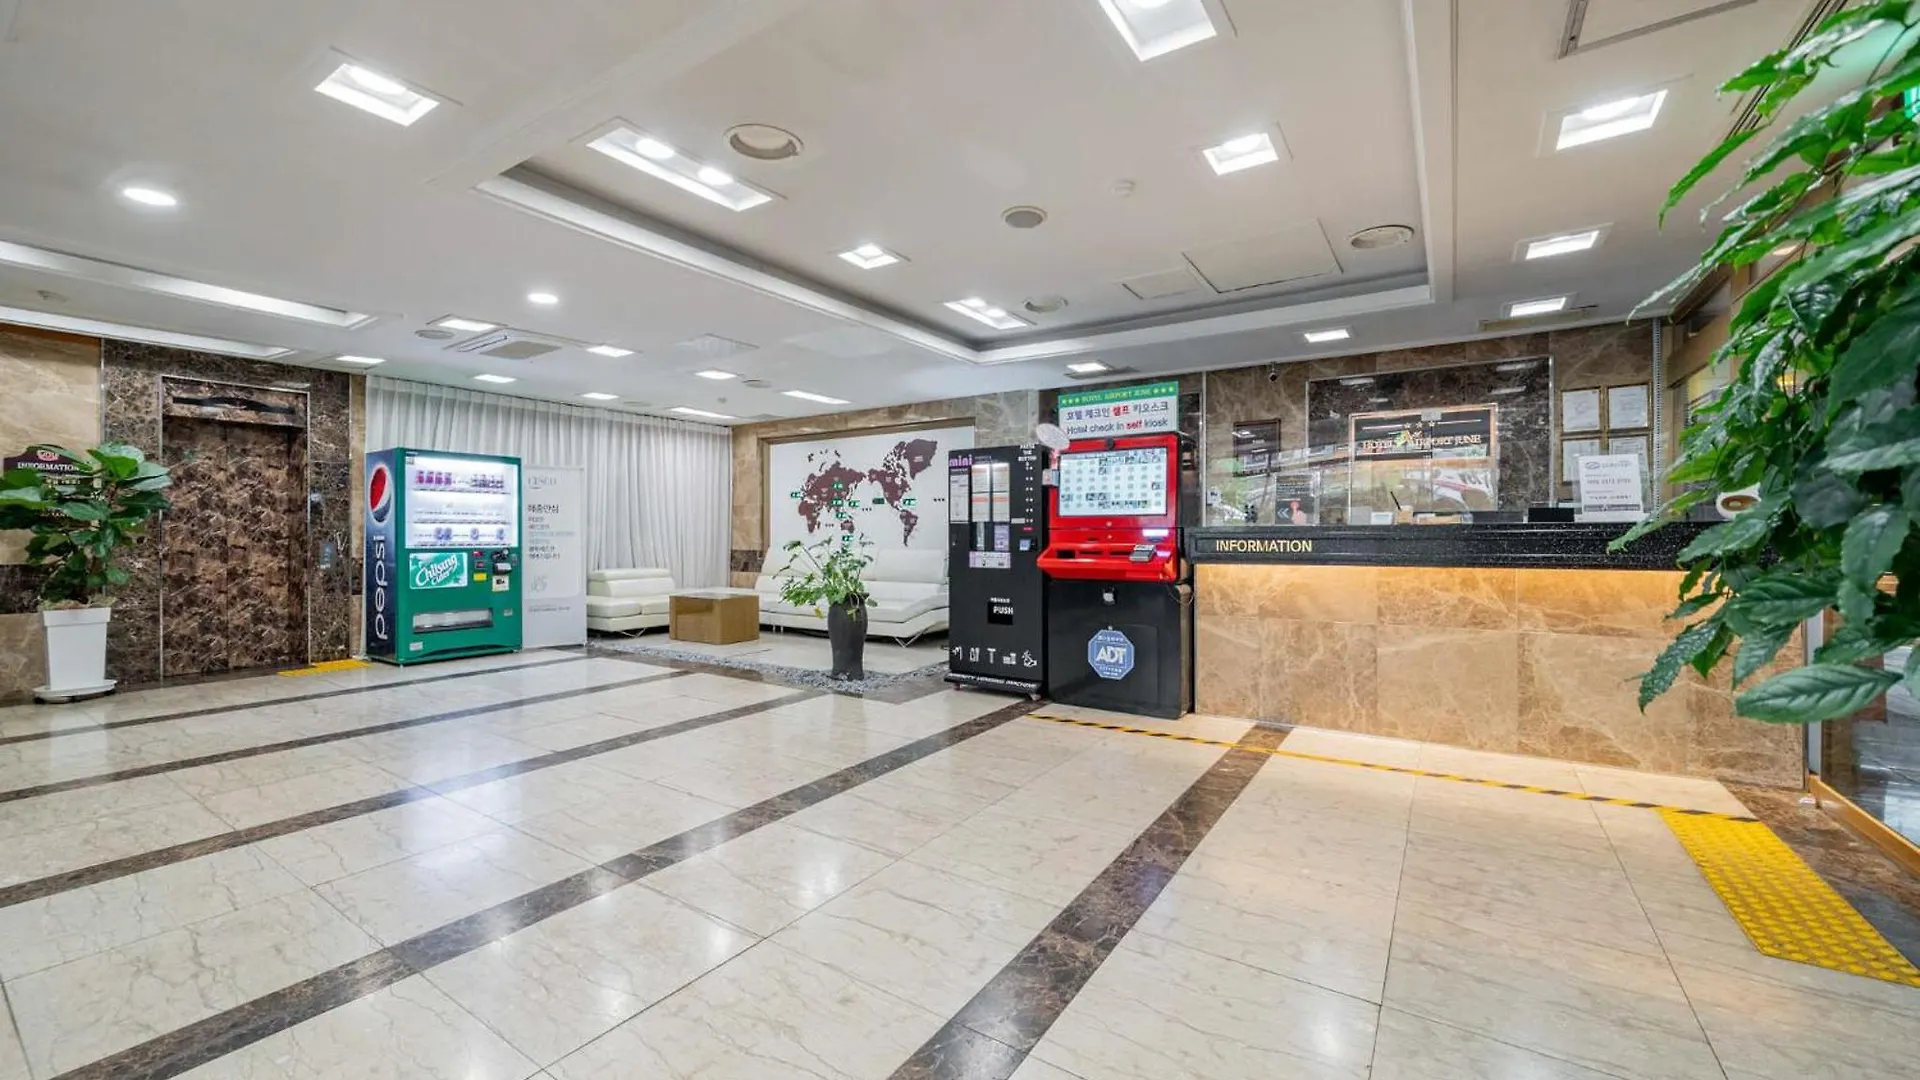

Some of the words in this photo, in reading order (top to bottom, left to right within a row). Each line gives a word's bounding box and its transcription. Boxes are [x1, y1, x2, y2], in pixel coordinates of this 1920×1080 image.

[1085, 407, 1110, 419] 체크인
[1112, 404, 1130, 417] 셀프
[1133, 401, 1168, 415] 키오스크
[1067, 424, 1088, 435] Hotel
[1090, 422, 1114, 433] check
[1116, 421, 1125, 431] in
[1126, 420, 1142, 431] self
[1144, 418, 1168, 429] kiosk
[1454, 434, 1482, 446] JUNE
[949, 454, 973, 467] mini
[1216, 539, 1312, 553] INFORMATION
[415, 553, 458, 586] Chilsung
[373, 535, 388, 641] pepsi
[993, 605, 1014, 615] PUSH
[1095, 645, 1127, 664] ADT
